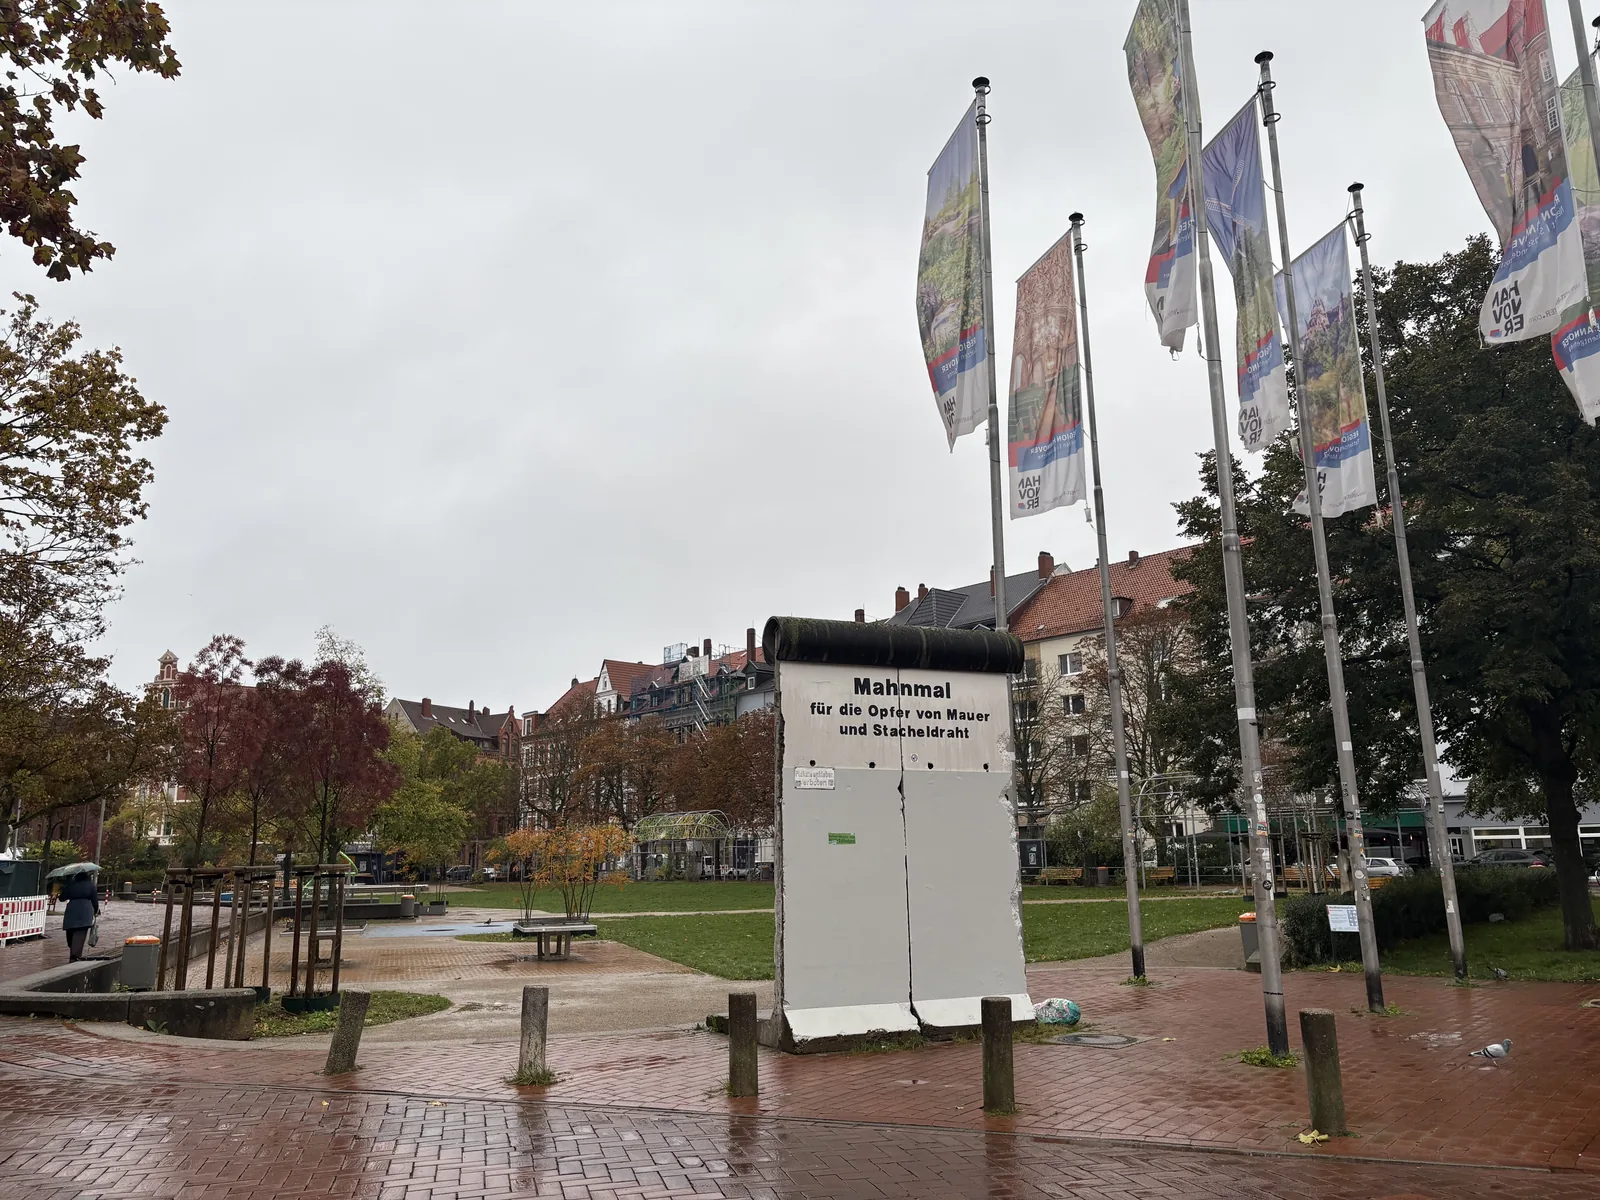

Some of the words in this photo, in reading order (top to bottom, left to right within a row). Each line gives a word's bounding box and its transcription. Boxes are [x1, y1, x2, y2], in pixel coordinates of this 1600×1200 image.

[854, 677, 951, 699] Mahnmal
[810, 702, 833, 715] für
[839, 703, 862, 716] die
[868, 705, 911, 720] Opfer
[916, 709, 942, 720] von
[947, 709, 990, 722] Mauer
[839, 723, 867, 736] und
[873, 724, 970, 739] Stacheldraht
